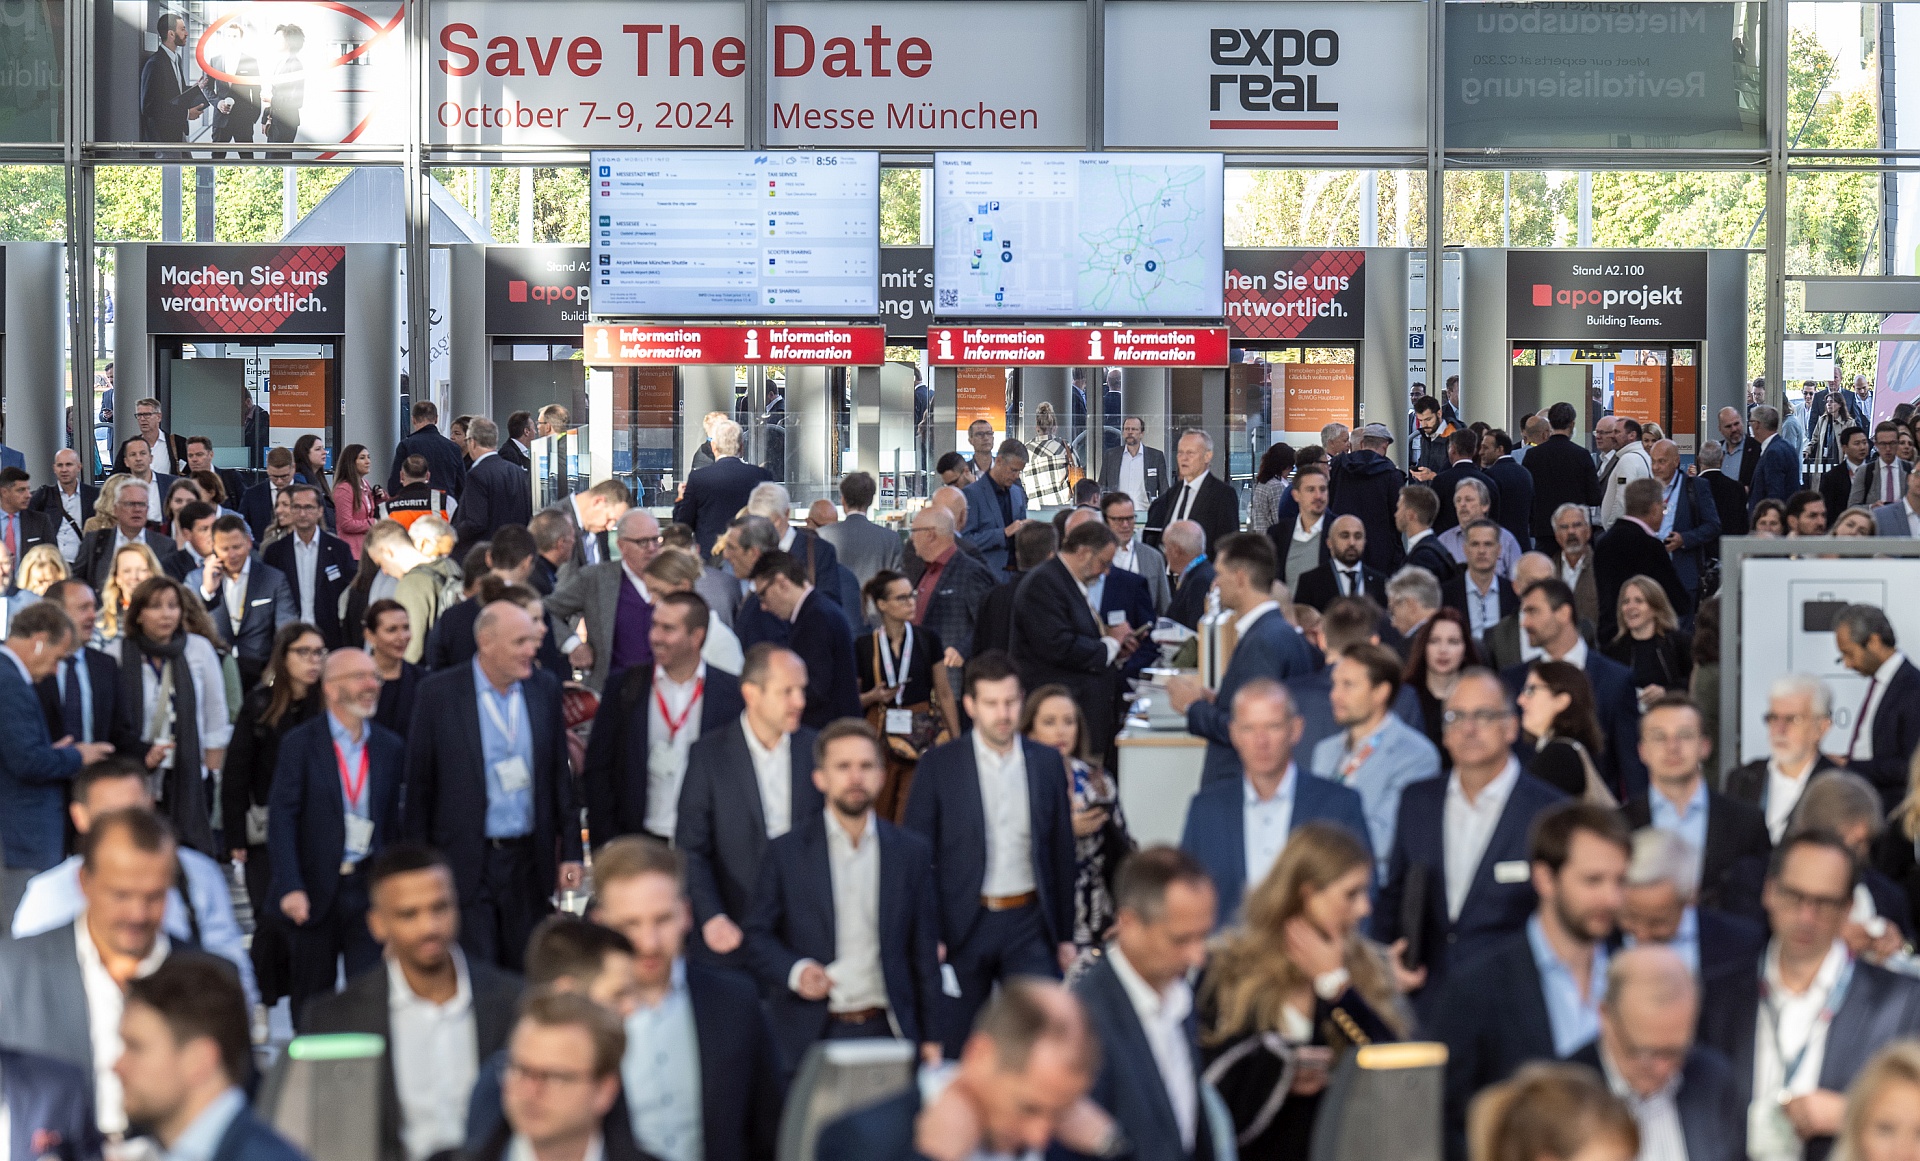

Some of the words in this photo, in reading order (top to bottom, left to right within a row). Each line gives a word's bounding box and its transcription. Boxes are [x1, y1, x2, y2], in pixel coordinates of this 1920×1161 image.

[437, 22, 603, 77] Save
[623, 24, 745, 77] The
[773, 24, 933, 78] Date
[1210, 28, 1339, 67] expo
[437, 100, 569, 128] October
[654, 102, 734, 129] 2024
[773, 102, 875, 129] Messe
[887, 101, 1038, 129] München
[816, 156, 838, 166] 8:56
[546, 260, 576, 272] Stand
[578, 260, 590, 272] A2
[1572, 265, 1602, 276] Stand
[1604, 265, 1645, 276] A2.100
[161, 265, 244, 285] Machen
[250, 265, 285, 285] Sie
[291, 270, 328, 286] uns
[1224, 270, 1267, 290] hen
[1273, 270, 1308, 291] Sie
[1313, 275, 1350, 291] uns
[160, 292, 327, 312] verantwortlich.
[531, 285, 590, 306] apop
[1556, 284, 1683, 310] apoprojekt
[920, 300, 934, 315] w
[1224, 297, 1348, 318] ntwortlich.
[561, 310, 590, 321] Buildi
[1586, 315, 1626, 327] Building
[1628, 315, 1662, 326] Teams.
[620, 329, 701, 343] Information
[770, 329, 851, 343] Information
[963, 330, 1044, 344] Information
[1113, 330, 1194, 344] Information
[620, 345, 702, 359] Information
[770, 345, 852, 359] Information
[963, 346, 1045, 360] Information
[1113, 347, 1195, 361] Information
[389, 499, 428, 509] SECURITY
